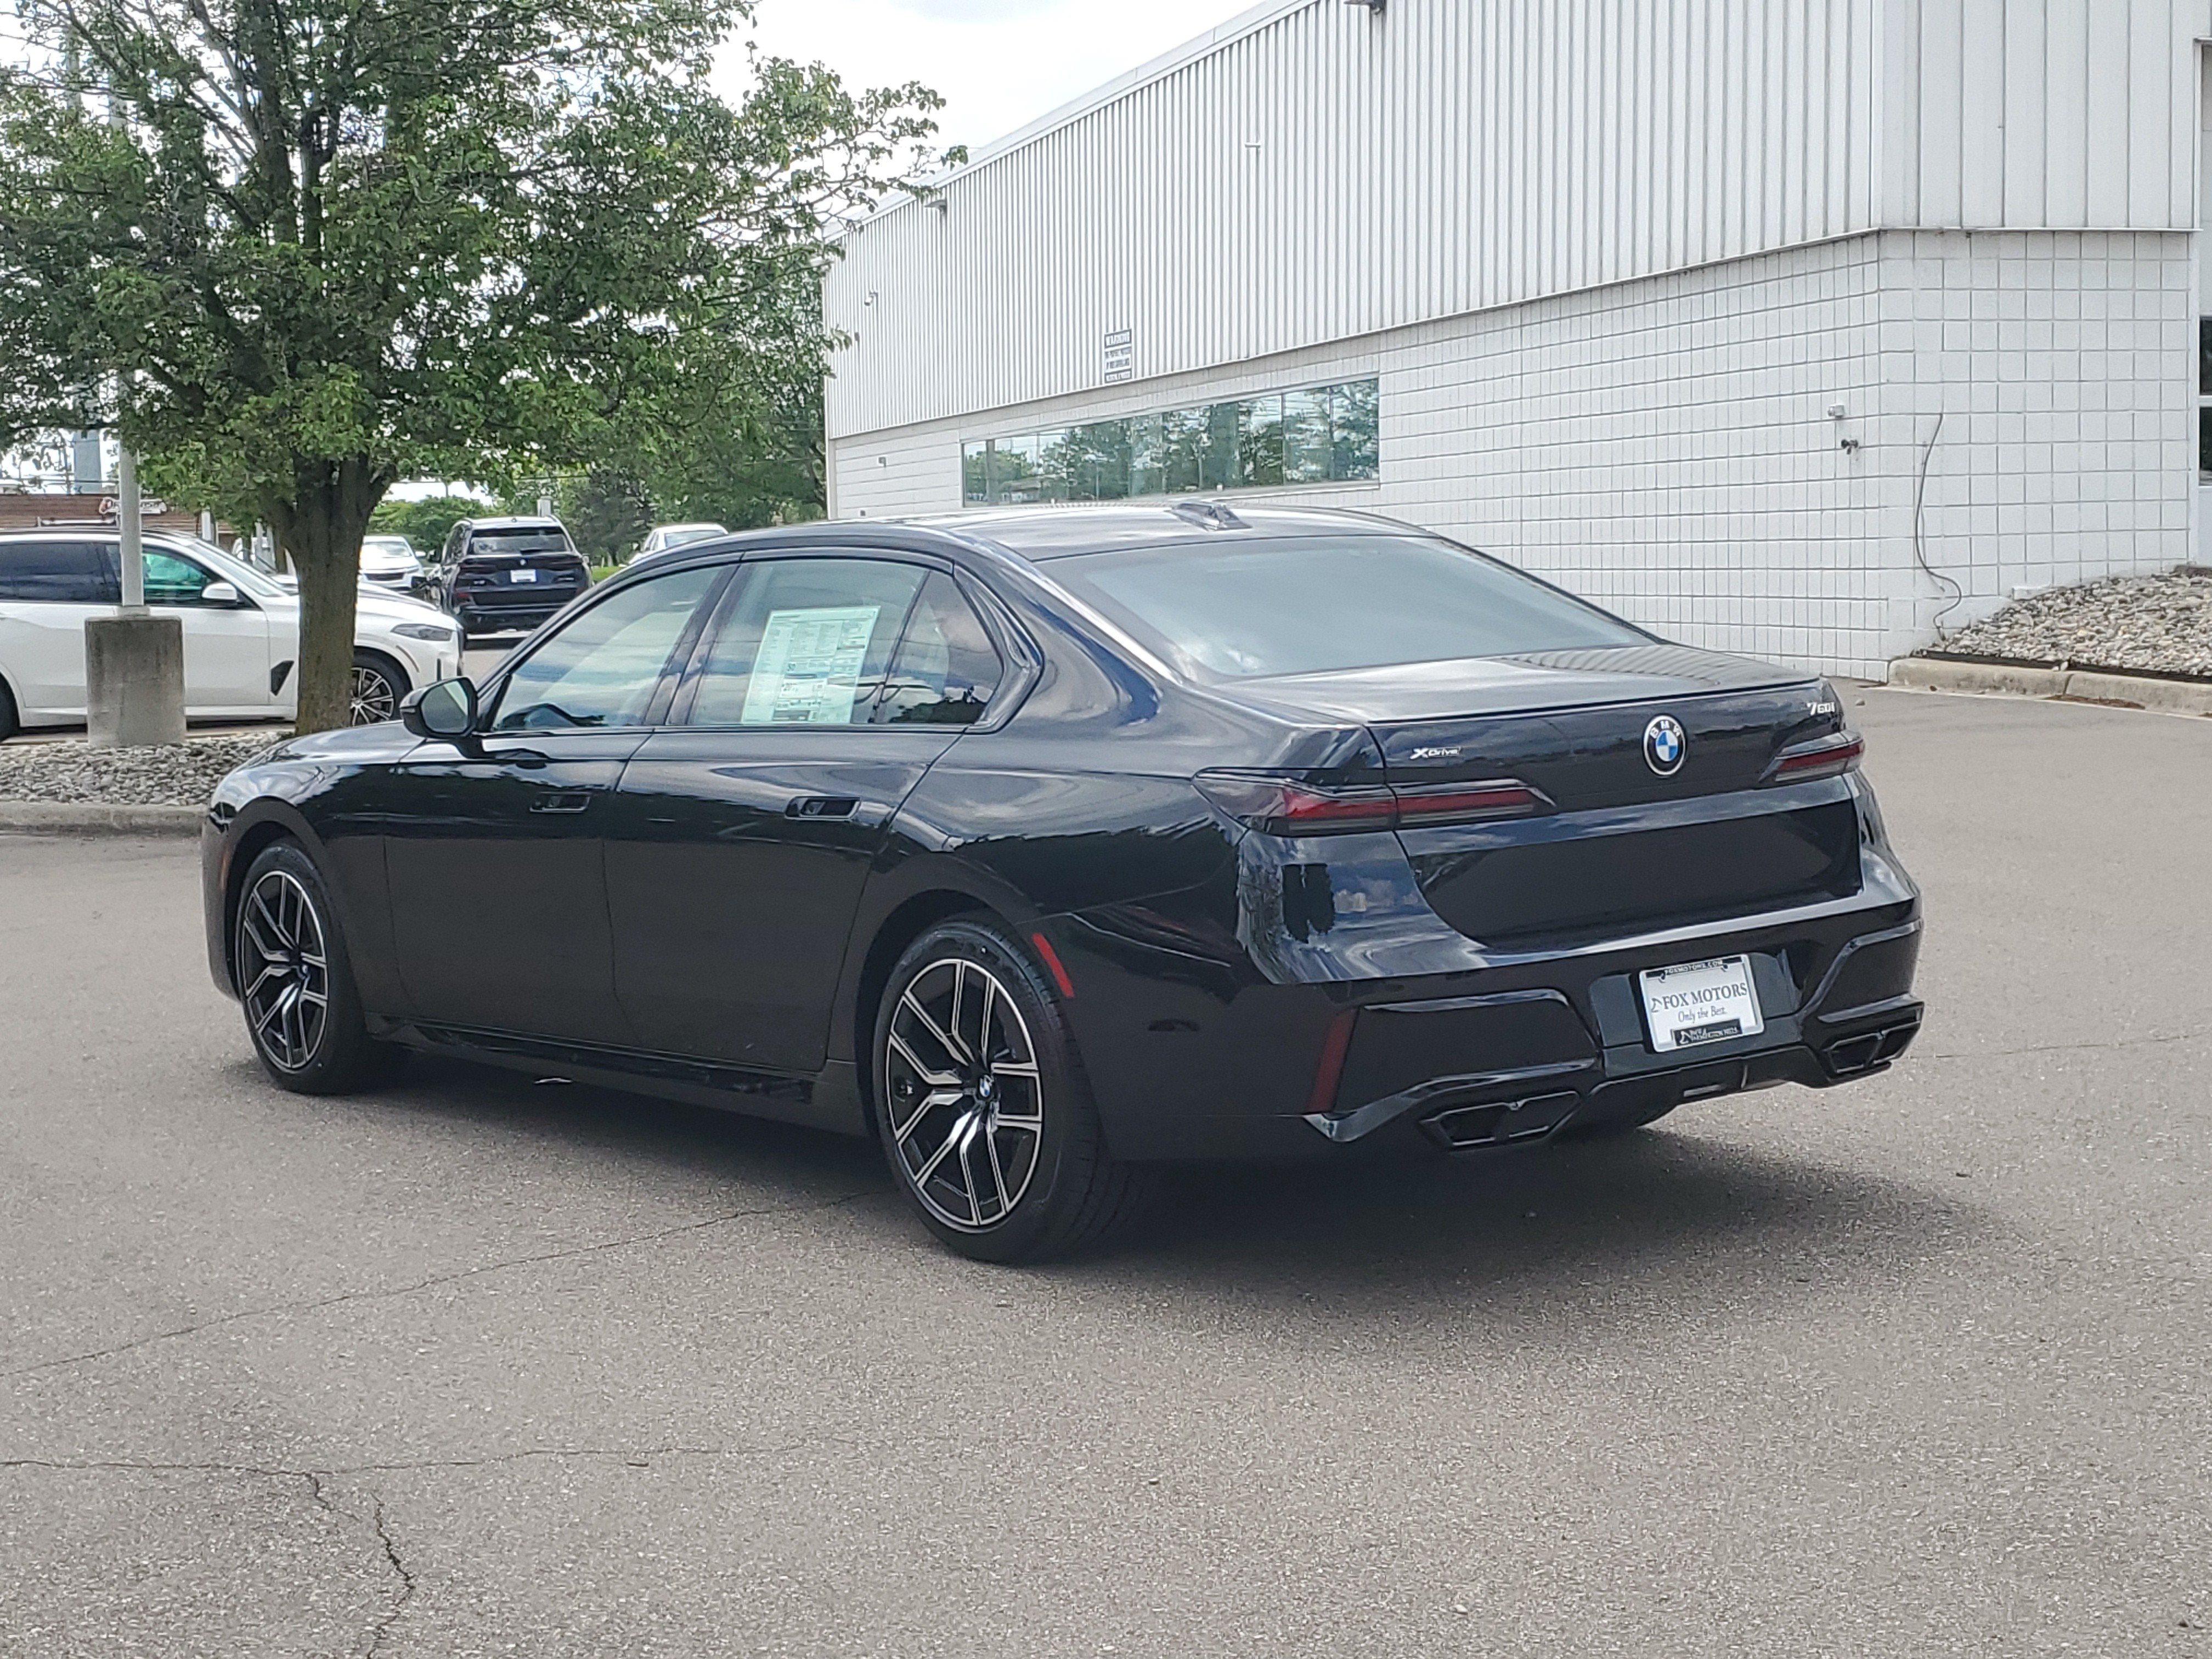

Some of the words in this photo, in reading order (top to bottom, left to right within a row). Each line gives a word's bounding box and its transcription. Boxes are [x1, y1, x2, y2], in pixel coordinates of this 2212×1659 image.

[1650, 720, 1681, 738] BMW
[1662, 992, 1689, 1009] FOX
[1690, 982, 1747, 1005] MOTORS
[1678, 1009, 1696, 1024] Only
[1697, 1007, 1709, 1018] the
